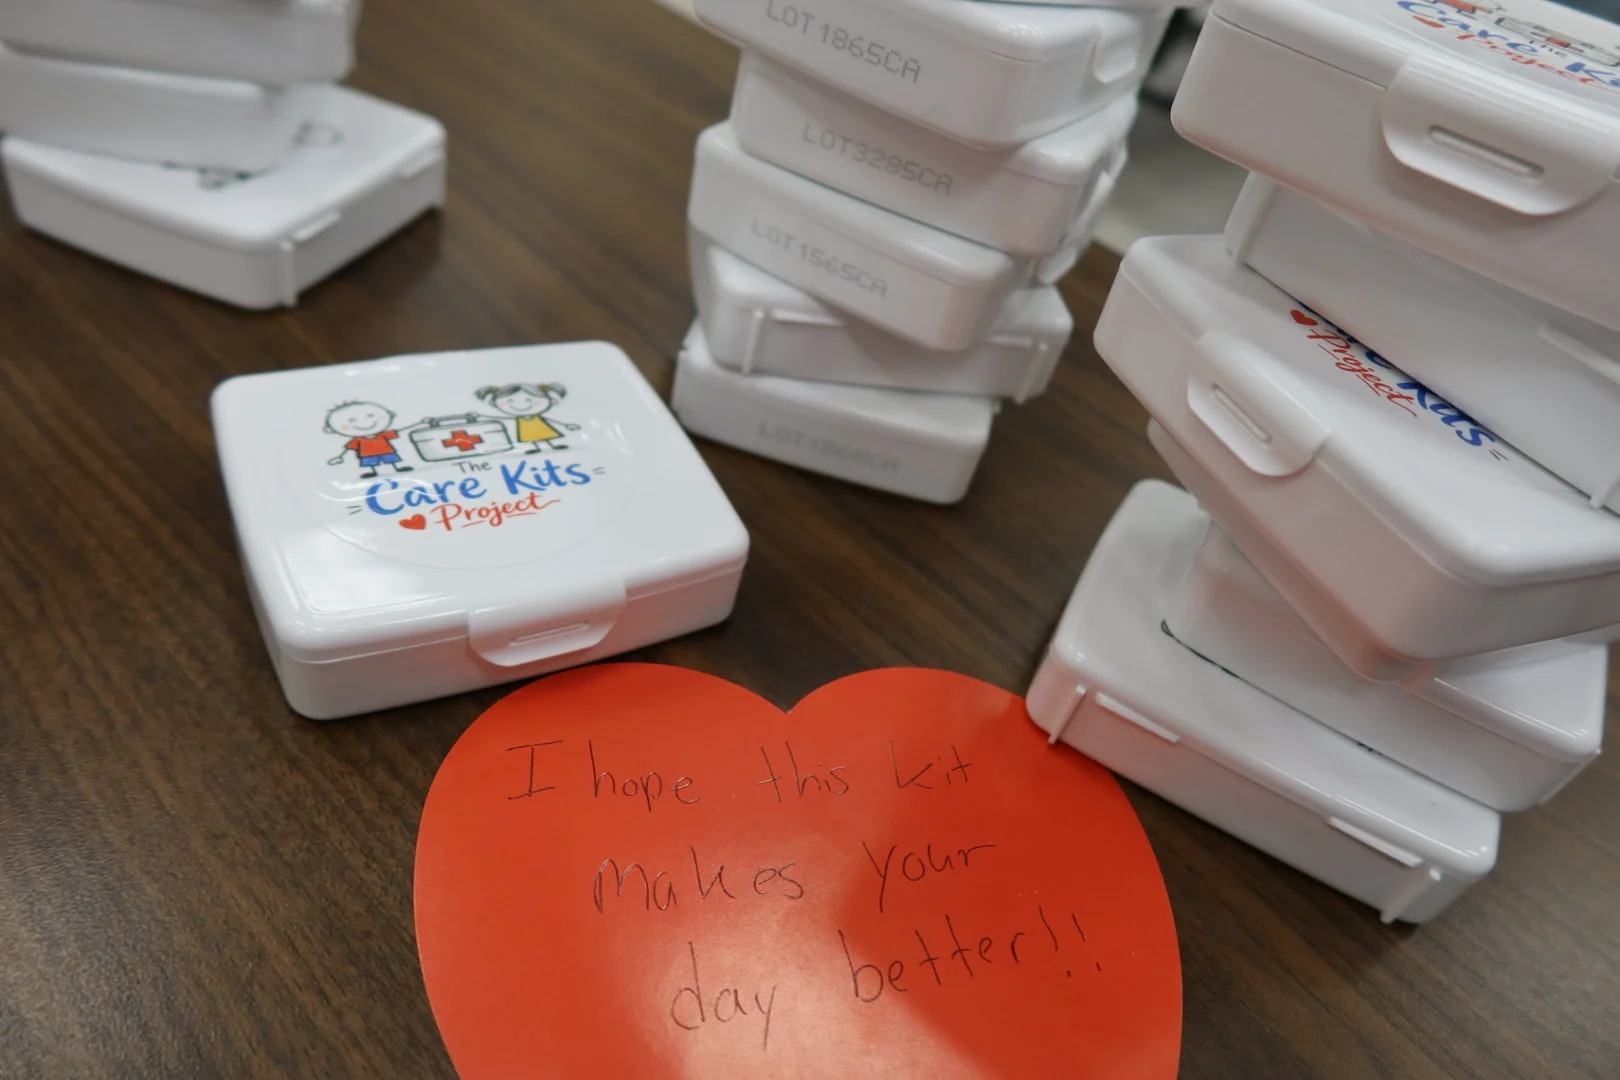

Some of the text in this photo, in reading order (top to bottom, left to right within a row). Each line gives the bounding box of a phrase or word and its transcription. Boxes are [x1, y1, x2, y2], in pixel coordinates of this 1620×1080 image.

[1307, 328, 1418, 417] Project
[365, 459, 592, 515] Care Kits
[454, 460, 492, 475] The
[430, 491, 562, 531] Project
[506, 740, 974, 811] I hope this kit
[671, 906, 1103, 1051] day better!!
